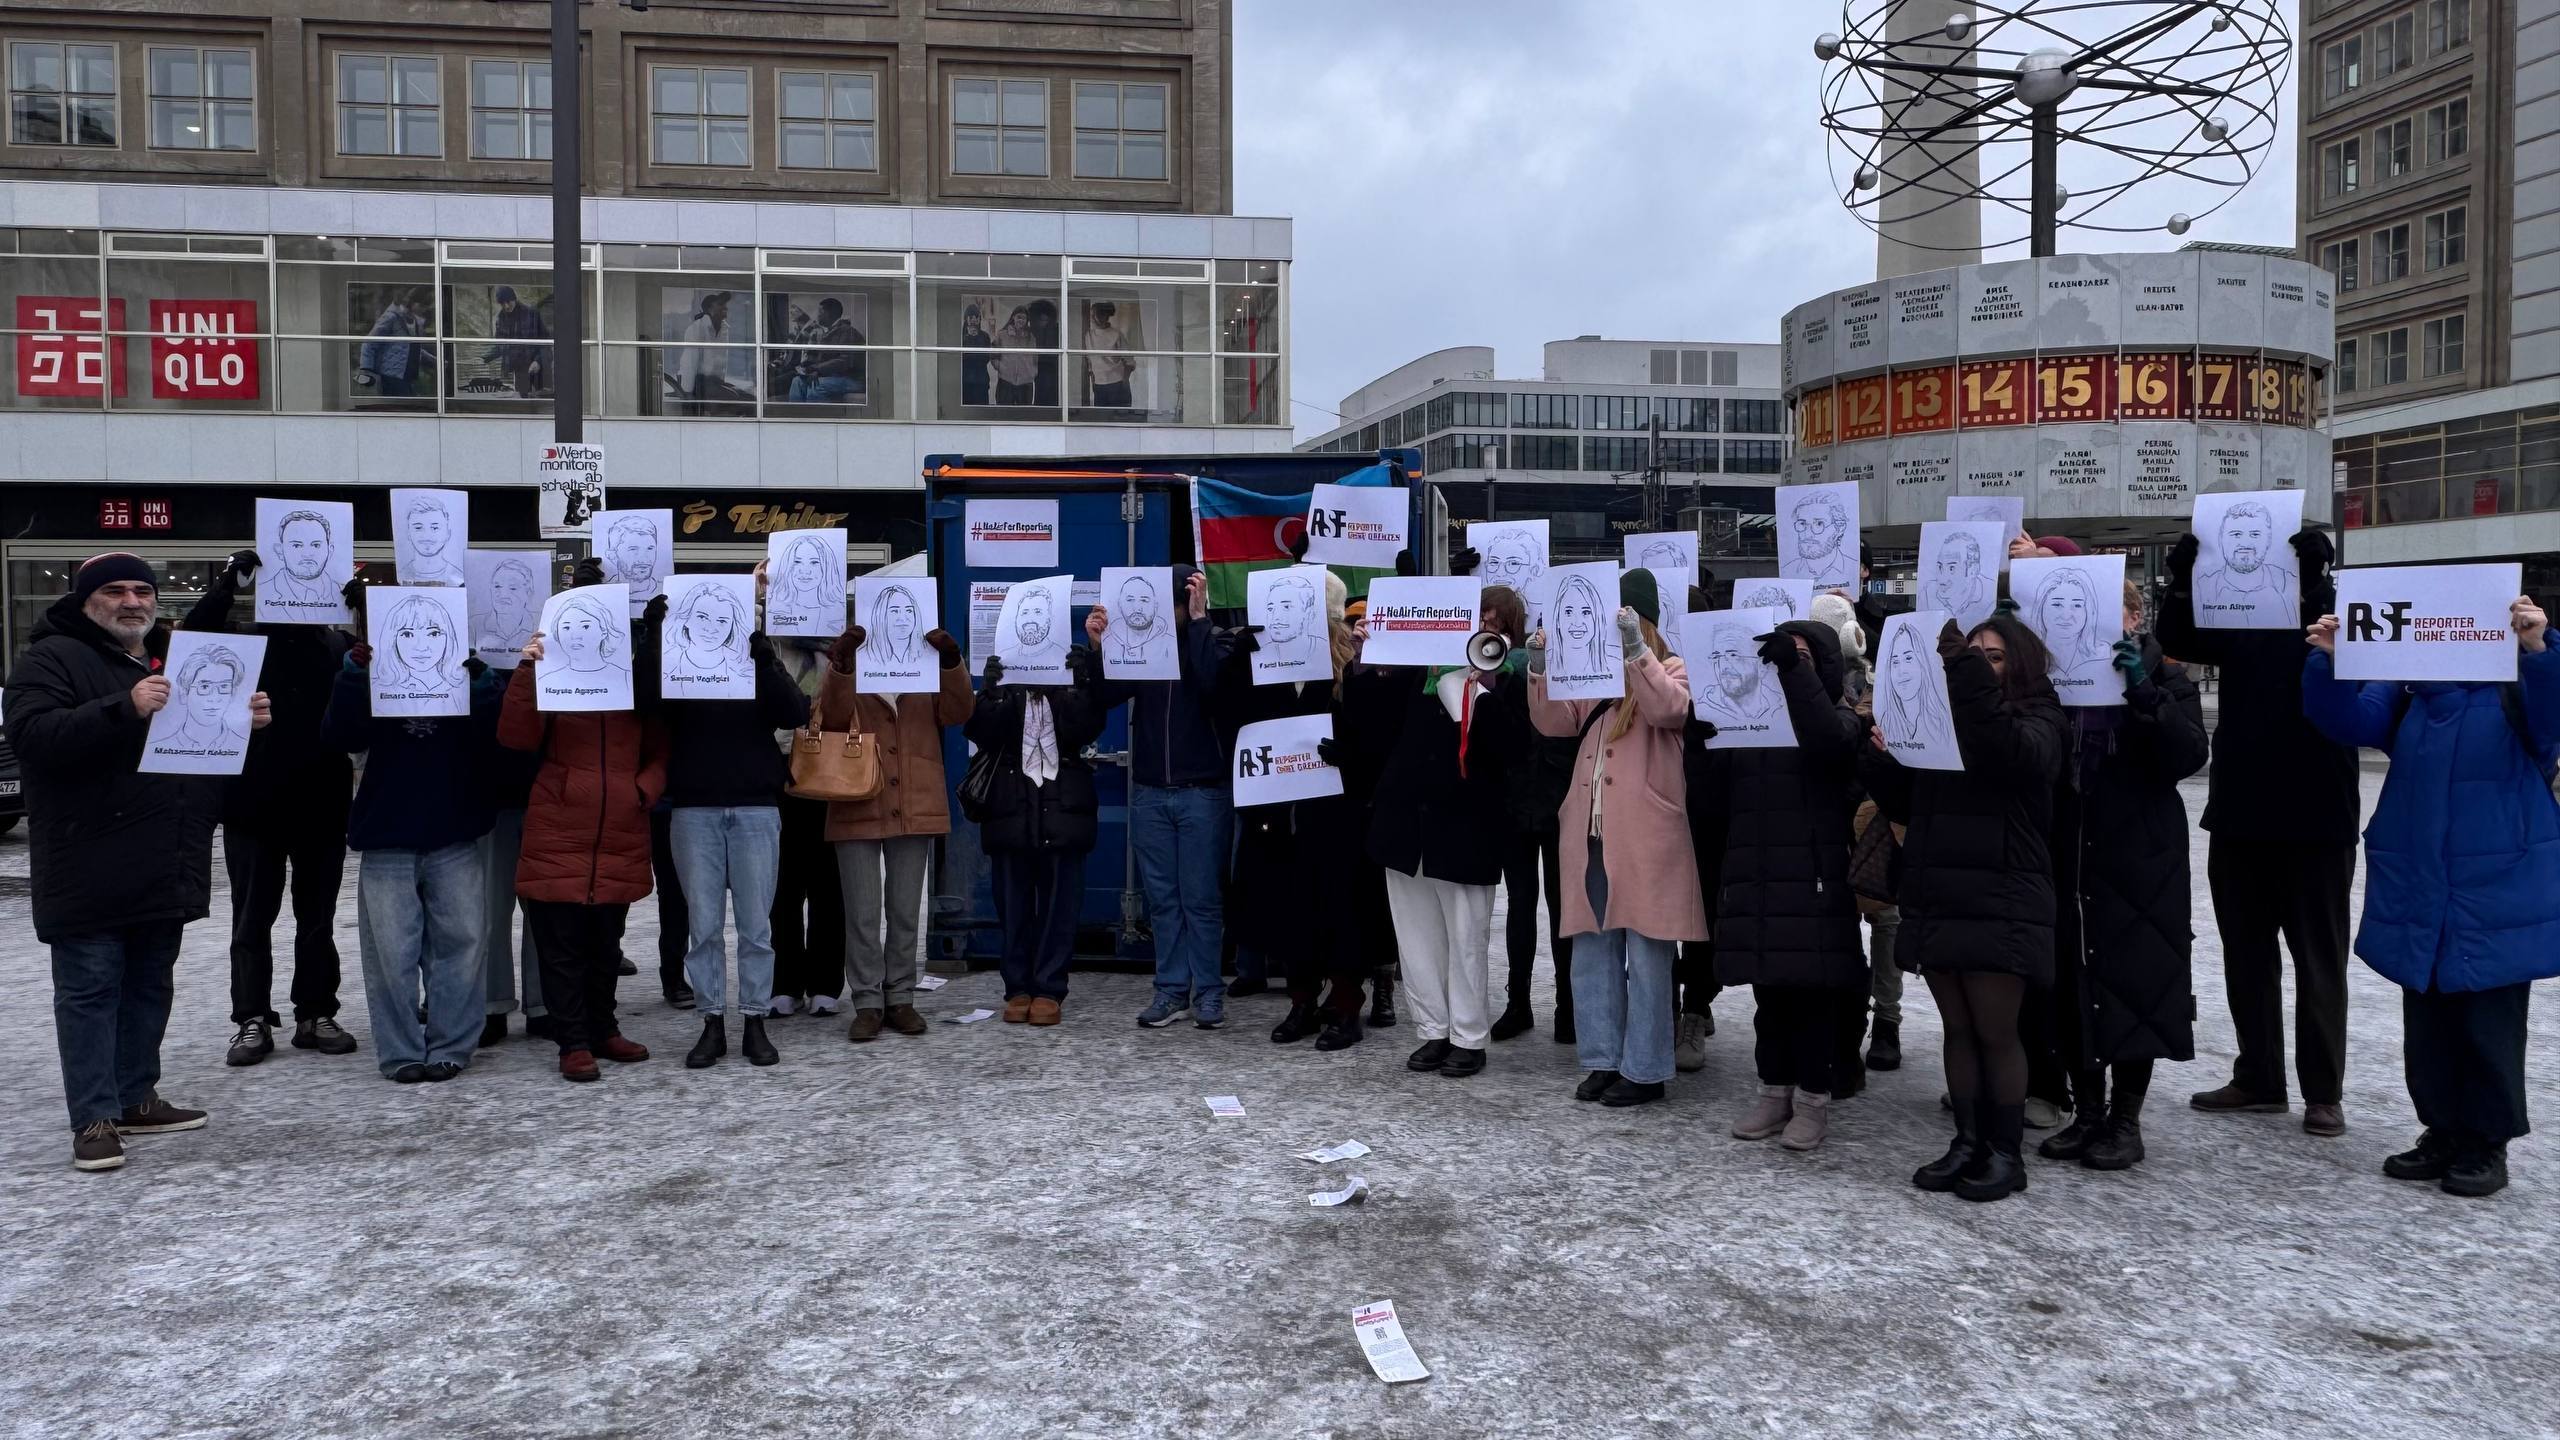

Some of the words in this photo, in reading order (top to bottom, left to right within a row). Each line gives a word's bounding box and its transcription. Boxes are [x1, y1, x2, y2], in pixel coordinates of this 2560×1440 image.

[1982, 294, 2013, 304] ALMATY
[162, 312, 237, 346] UNI
[164, 353, 244, 392] QLO
[1814, 397, 1834, 434] 11
[1848, 386, 1882, 427] 12
[1896, 376, 1944, 419] 13
[1961, 370, 2013, 412] 14
[2037, 366, 2092, 407] 15
[2114, 363, 2168, 404] 16
[2187, 364, 2233, 404] 17
[2248, 368, 2280, 410] 18
[556, 446, 602, 460] Werbe
[2064, 450, 2092, 458] HANOI
[540, 459, 598, 472] monitore
[2058, 459, 2097, 467] BANGKOK
[2142, 458, 2175, 466] MANILA
[585, 471, 602, 482] ab
[1968, 472, 2004, 480] RANGUN
[2050, 468, 2080, 477] PHNOM
[2083, 467, 2106, 475] PENH
[1981, 480, 2011, 488] DHAKA
[2058, 476, 2098, 484] JAKARTA
[2136, 475, 2181, 483] HONGKONG
[541, 479, 595, 492] schalten
[2128, 484, 2154, 492] KUALA
[2157, 484, 2188, 492] LUMPUR
[2138, 493, 2178, 501] SINGAPUR
[143, 502, 167, 513] UNI
[143, 514, 169, 527] QLO
[728, 502, 849, 533] Tchibo
[1310, 508, 1347, 538] RSF
[1371, 606, 1472, 632] #NoAirForReporting
[2347, 602, 2413, 641] RSF
[2414, 617, 2475, 629] REPORTER
[2414, 630, 2447, 642] OHNE
[2449, 629, 2505, 642] GRENZEN
[1239, 745, 1274, 778] RSF
